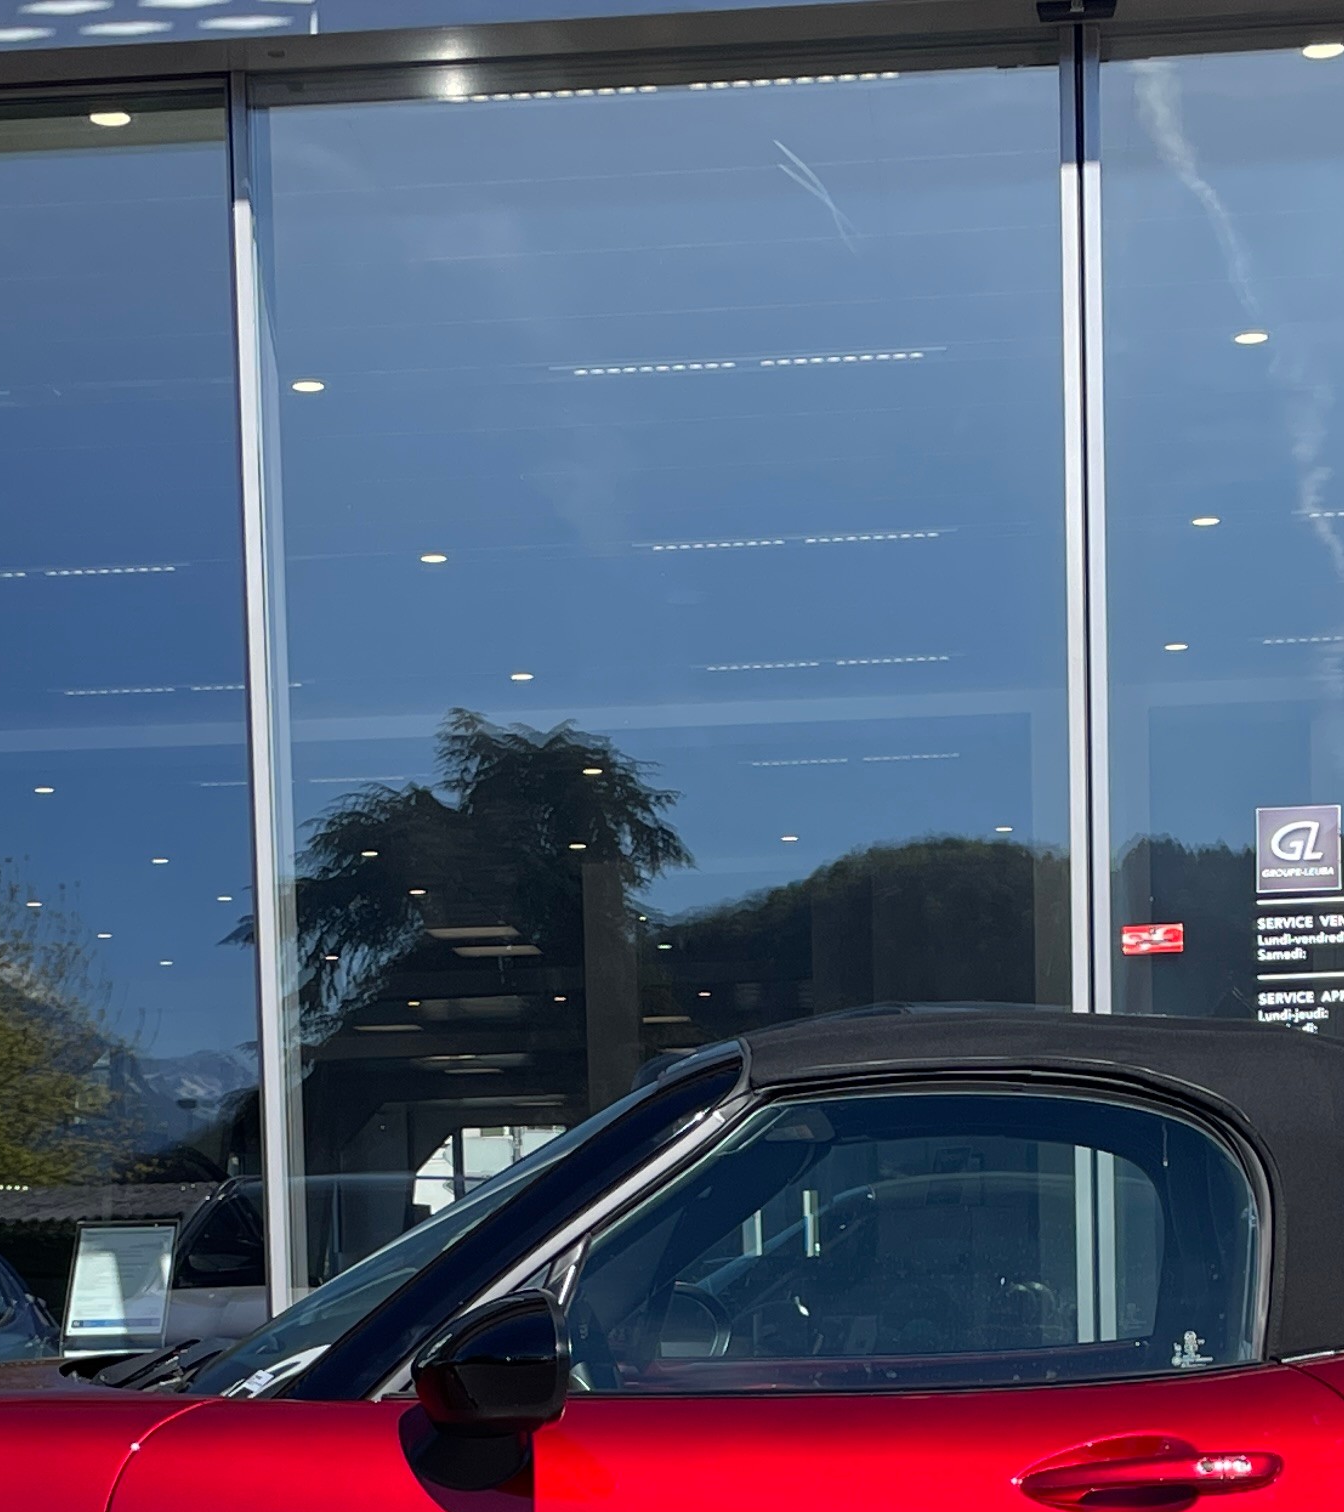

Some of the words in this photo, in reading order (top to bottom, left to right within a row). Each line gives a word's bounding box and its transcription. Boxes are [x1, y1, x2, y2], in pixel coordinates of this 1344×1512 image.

[1271, 820, 1324, 861] GL
[1257, 915, 1314, 930] SERVICE
[1257, 947, 1307, 961] Samedi:
[1257, 990, 1315, 1006] SERVICE
